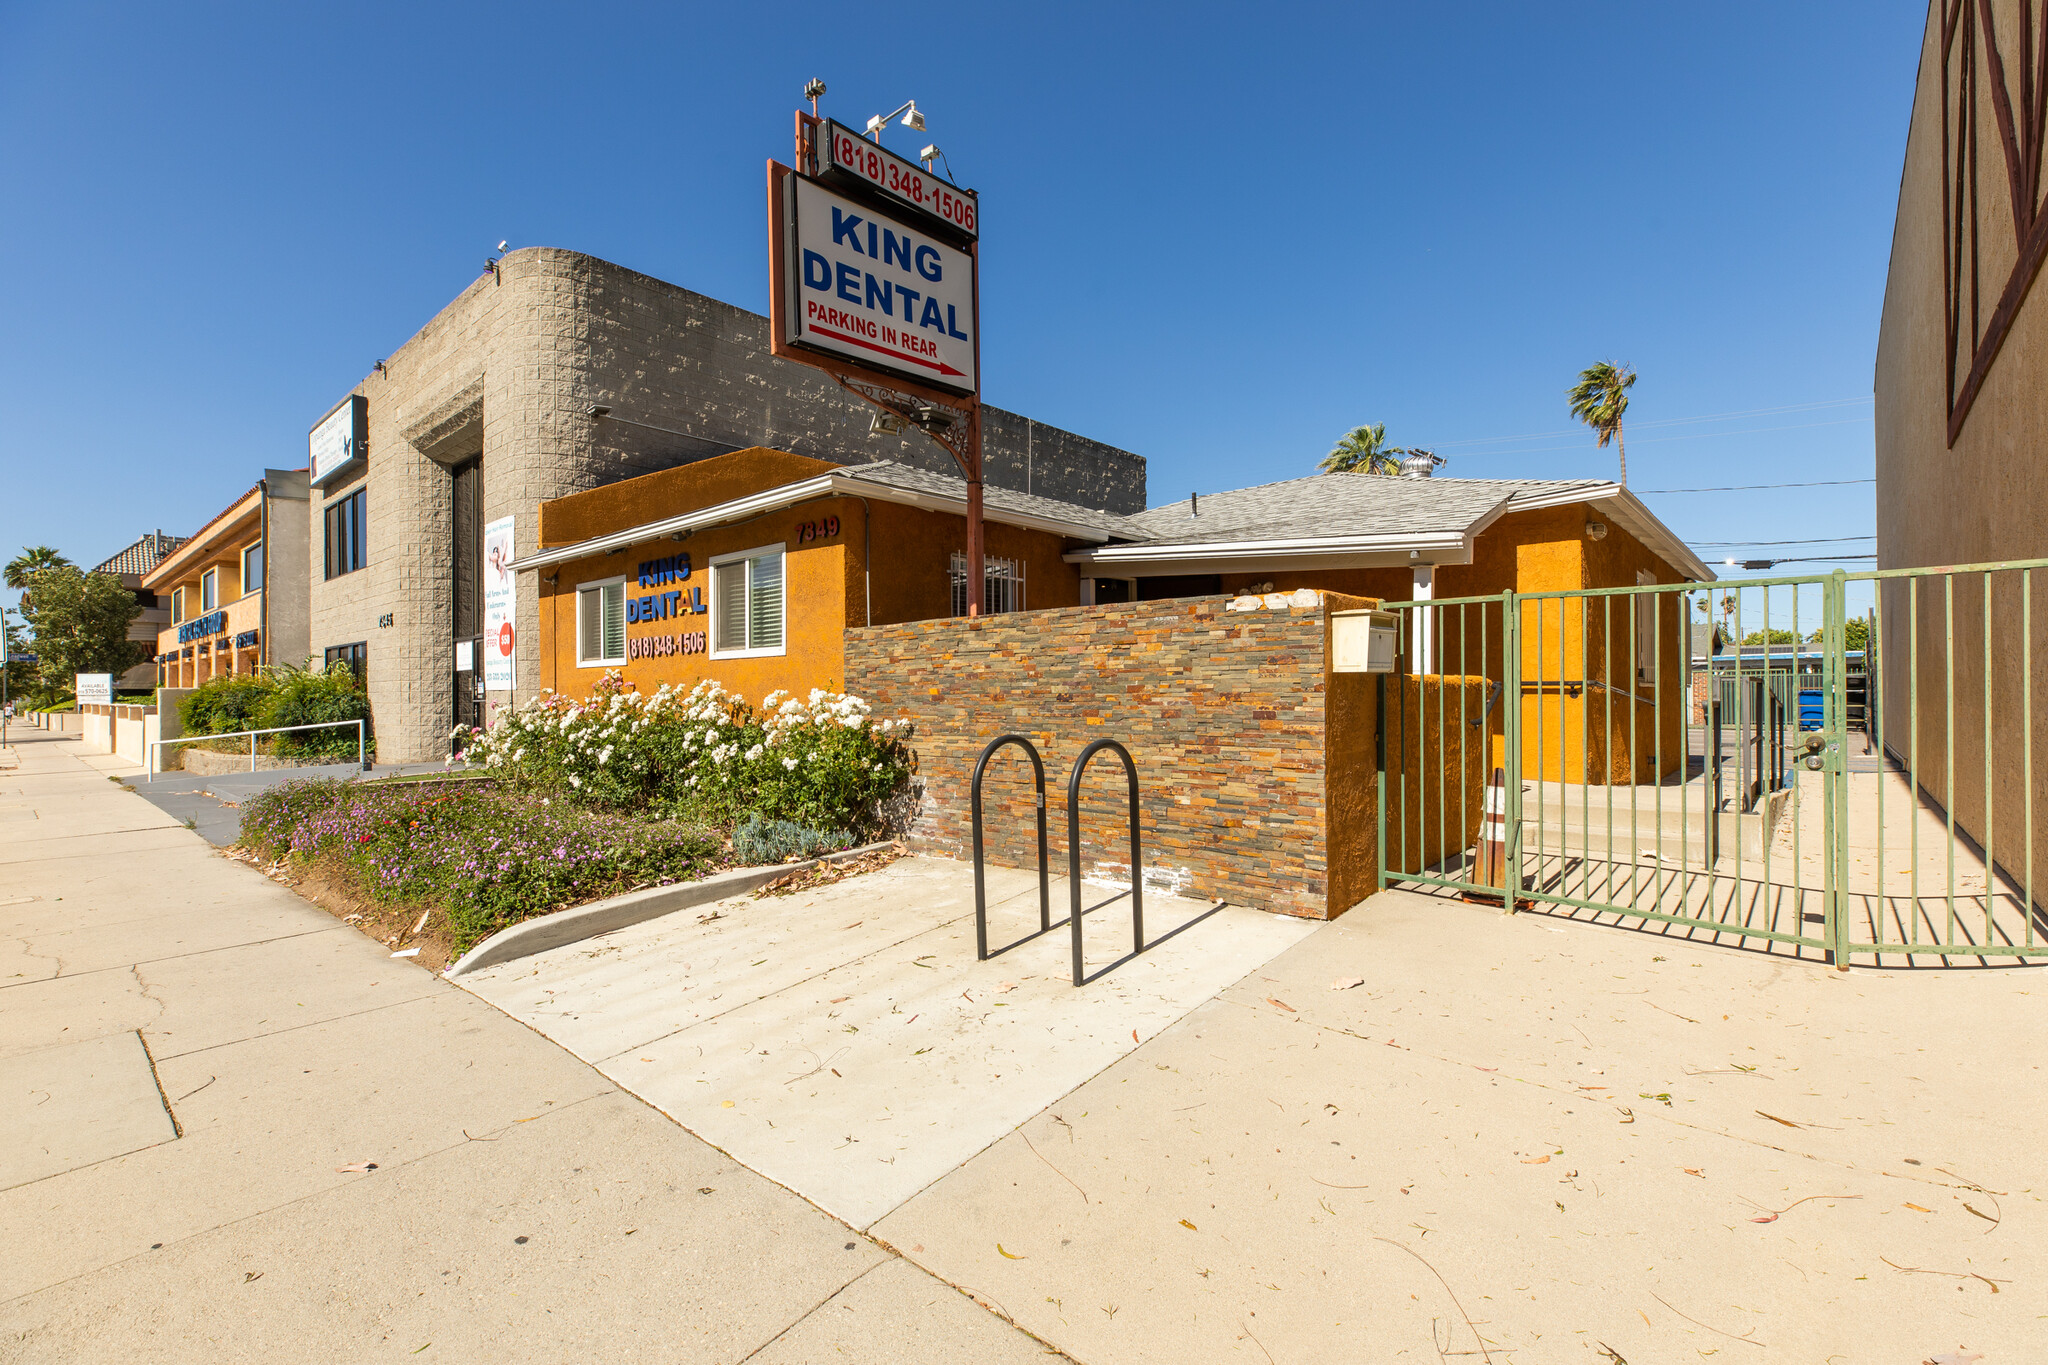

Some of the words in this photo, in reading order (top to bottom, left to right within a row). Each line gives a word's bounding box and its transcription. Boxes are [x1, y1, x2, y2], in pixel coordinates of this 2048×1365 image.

[834, 133, 974, 230] (818)348-1506
[832, 206, 942, 283] KING
[803, 247, 968, 342] DENTAL
[807, 300, 877, 339] PARKING
[881, 325, 897, 345] IN
[901, 331, 938, 359] REAR
[795, 516, 840, 544] 7349
[637, 552, 691, 588] KING
[626, 586, 707, 623] DENTAL
[627, 630, 707, 660] (818)348-1506
